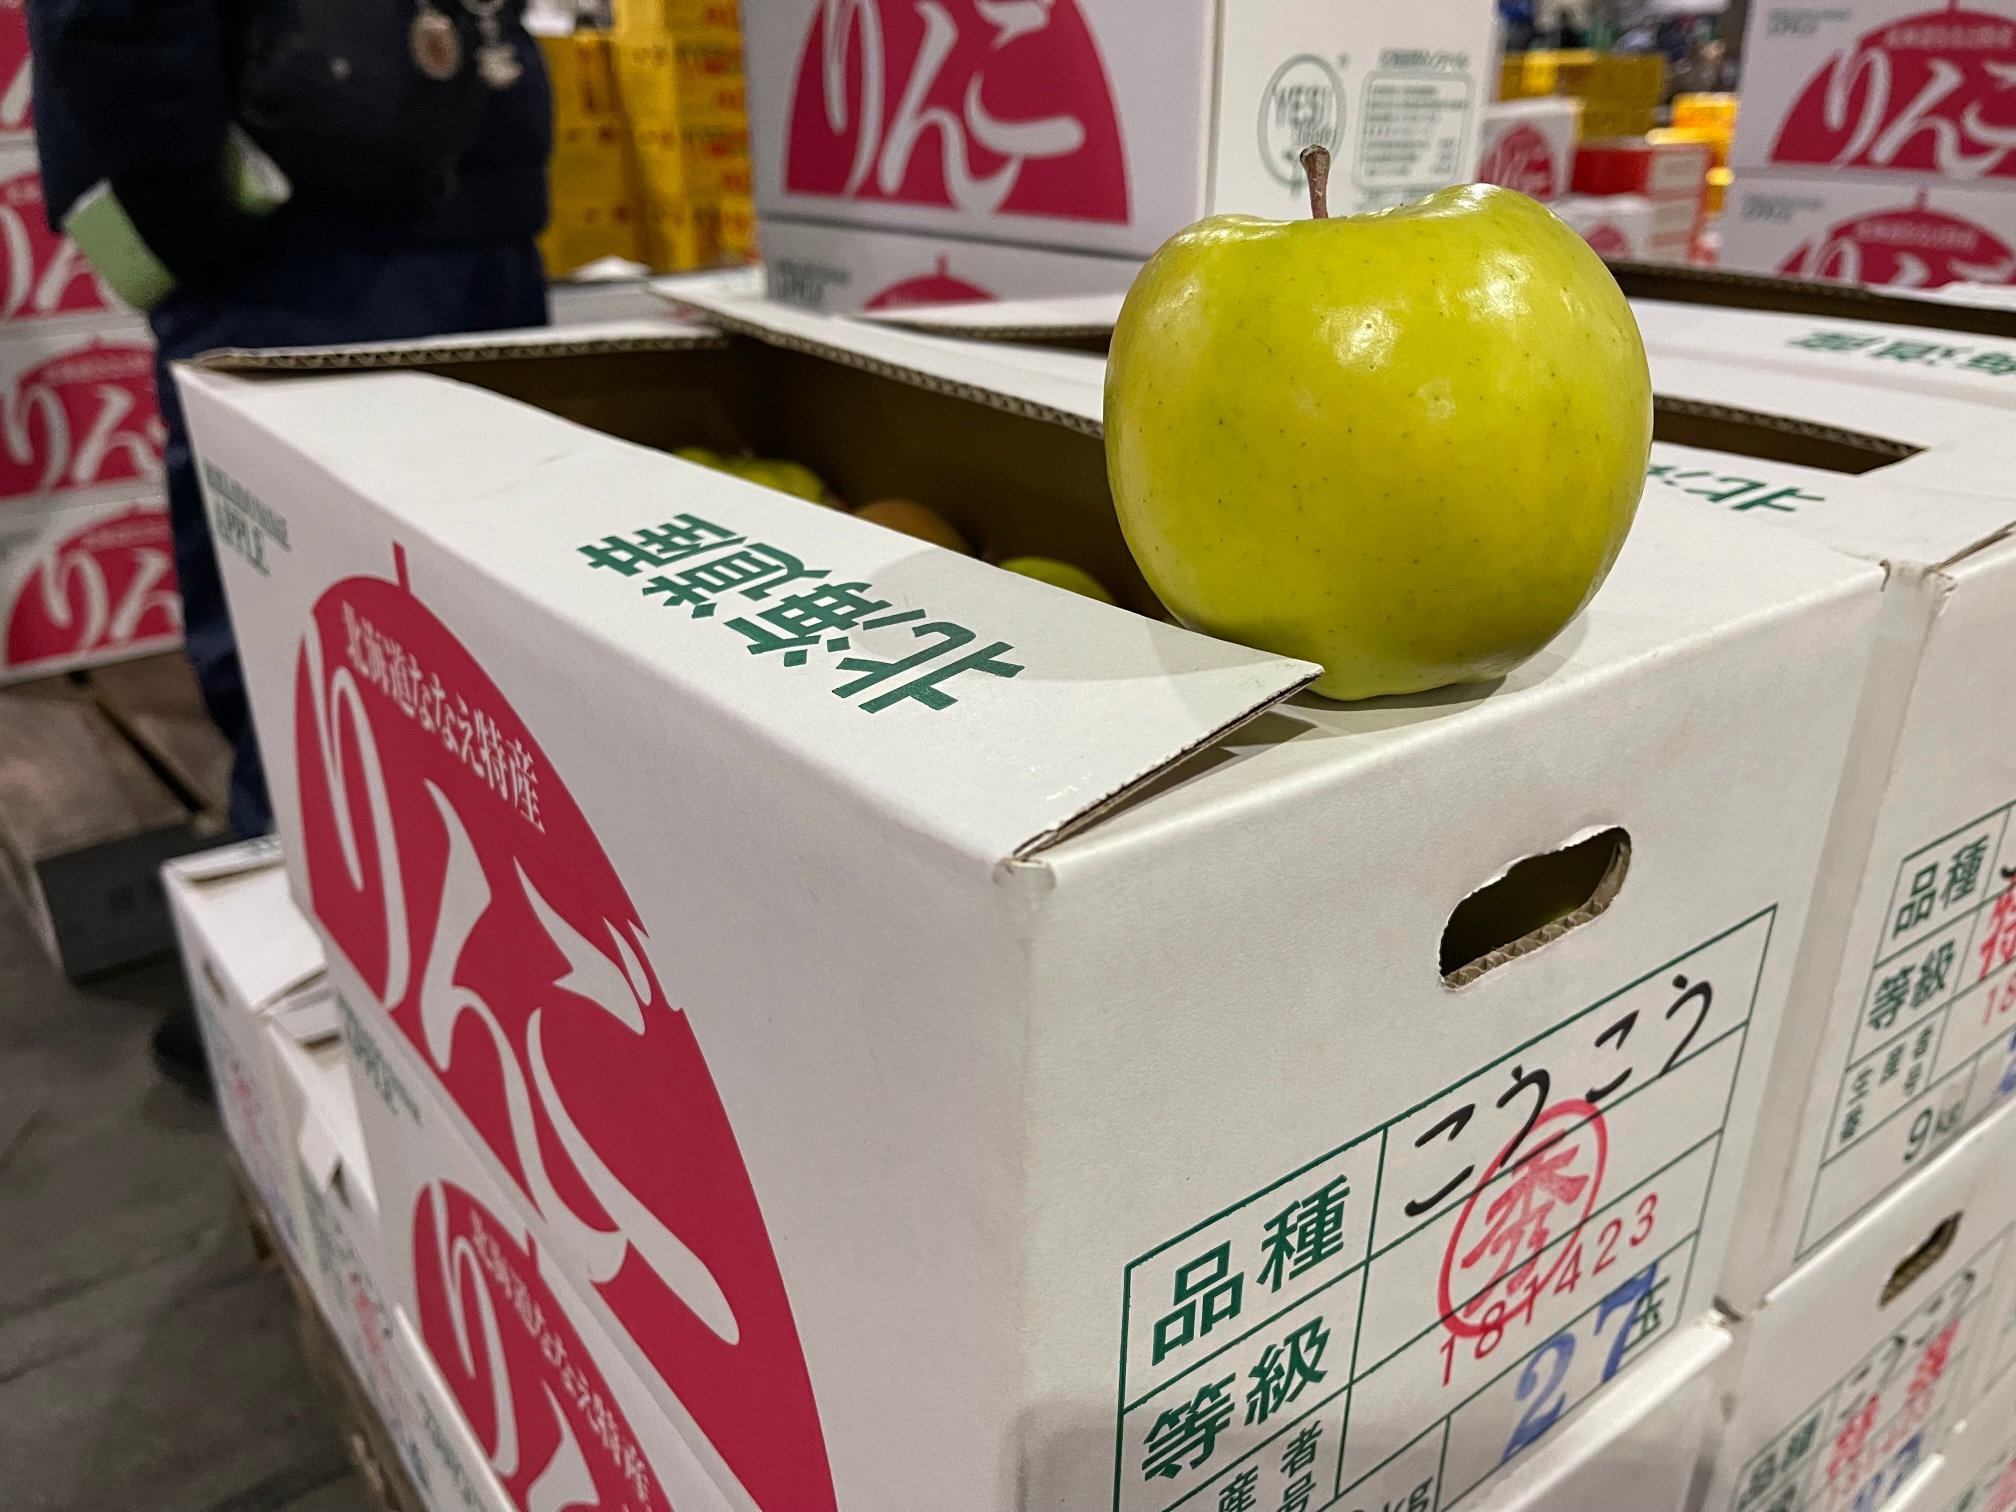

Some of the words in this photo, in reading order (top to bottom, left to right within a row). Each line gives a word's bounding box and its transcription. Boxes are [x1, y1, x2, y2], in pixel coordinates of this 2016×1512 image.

[4, 383, 166, 498] りん
[576, 513, 1026, 714] 北海道産
[342, 600, 547, 835] 北海道ななえ特産
[303, 612, 741, 1345] りんご
[1892, 833, 1991, 941] 品種
[1405, 973, 1713, 1217] こうこう
[1151, 1174, 1352, 1367] 品種
[1502, 1262, 1658, 1462] 27
[1141, 1315, 1331, 1481] 等級
